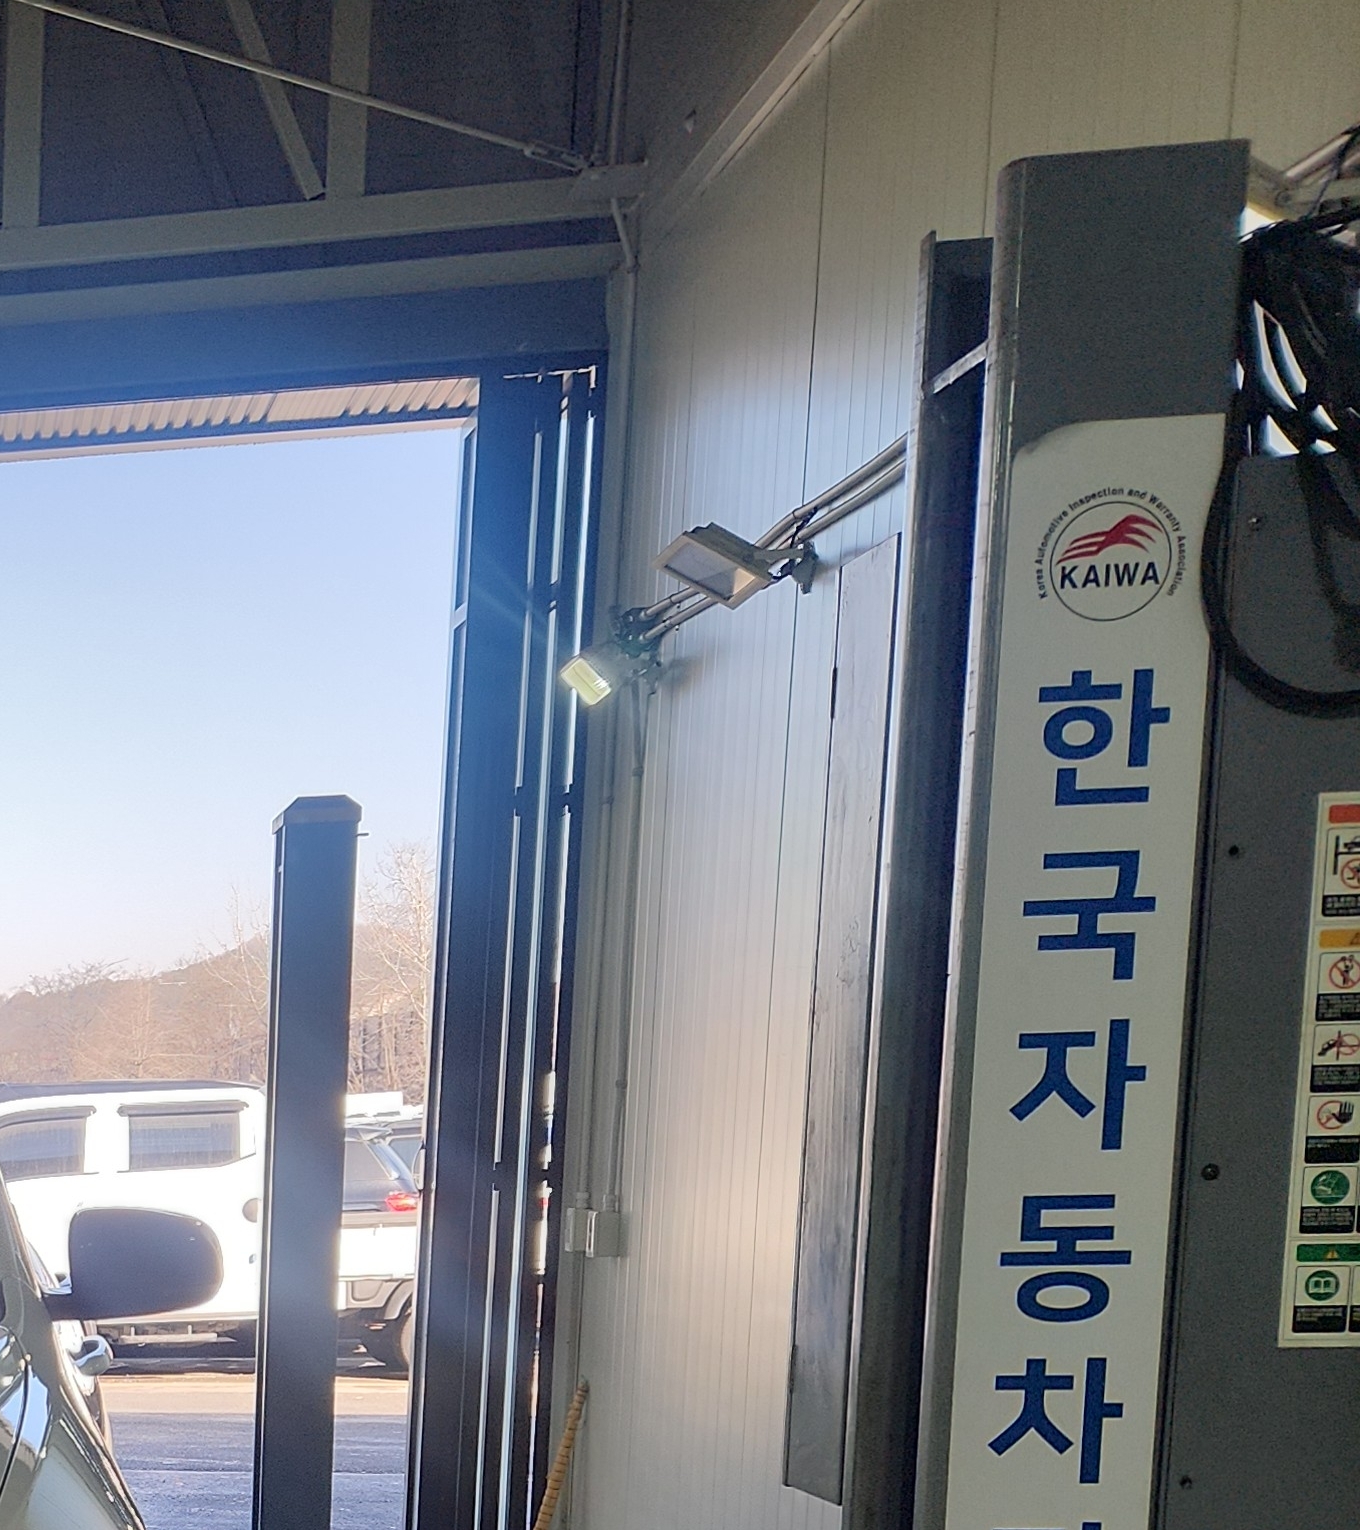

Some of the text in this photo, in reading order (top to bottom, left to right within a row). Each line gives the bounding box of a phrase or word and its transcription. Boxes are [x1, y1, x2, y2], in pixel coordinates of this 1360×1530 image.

[1068, 486, 1124, 512] Inspection
[1128, 488, 1148, 500] and
[1059, 561, 1161, 590] KAIWA
